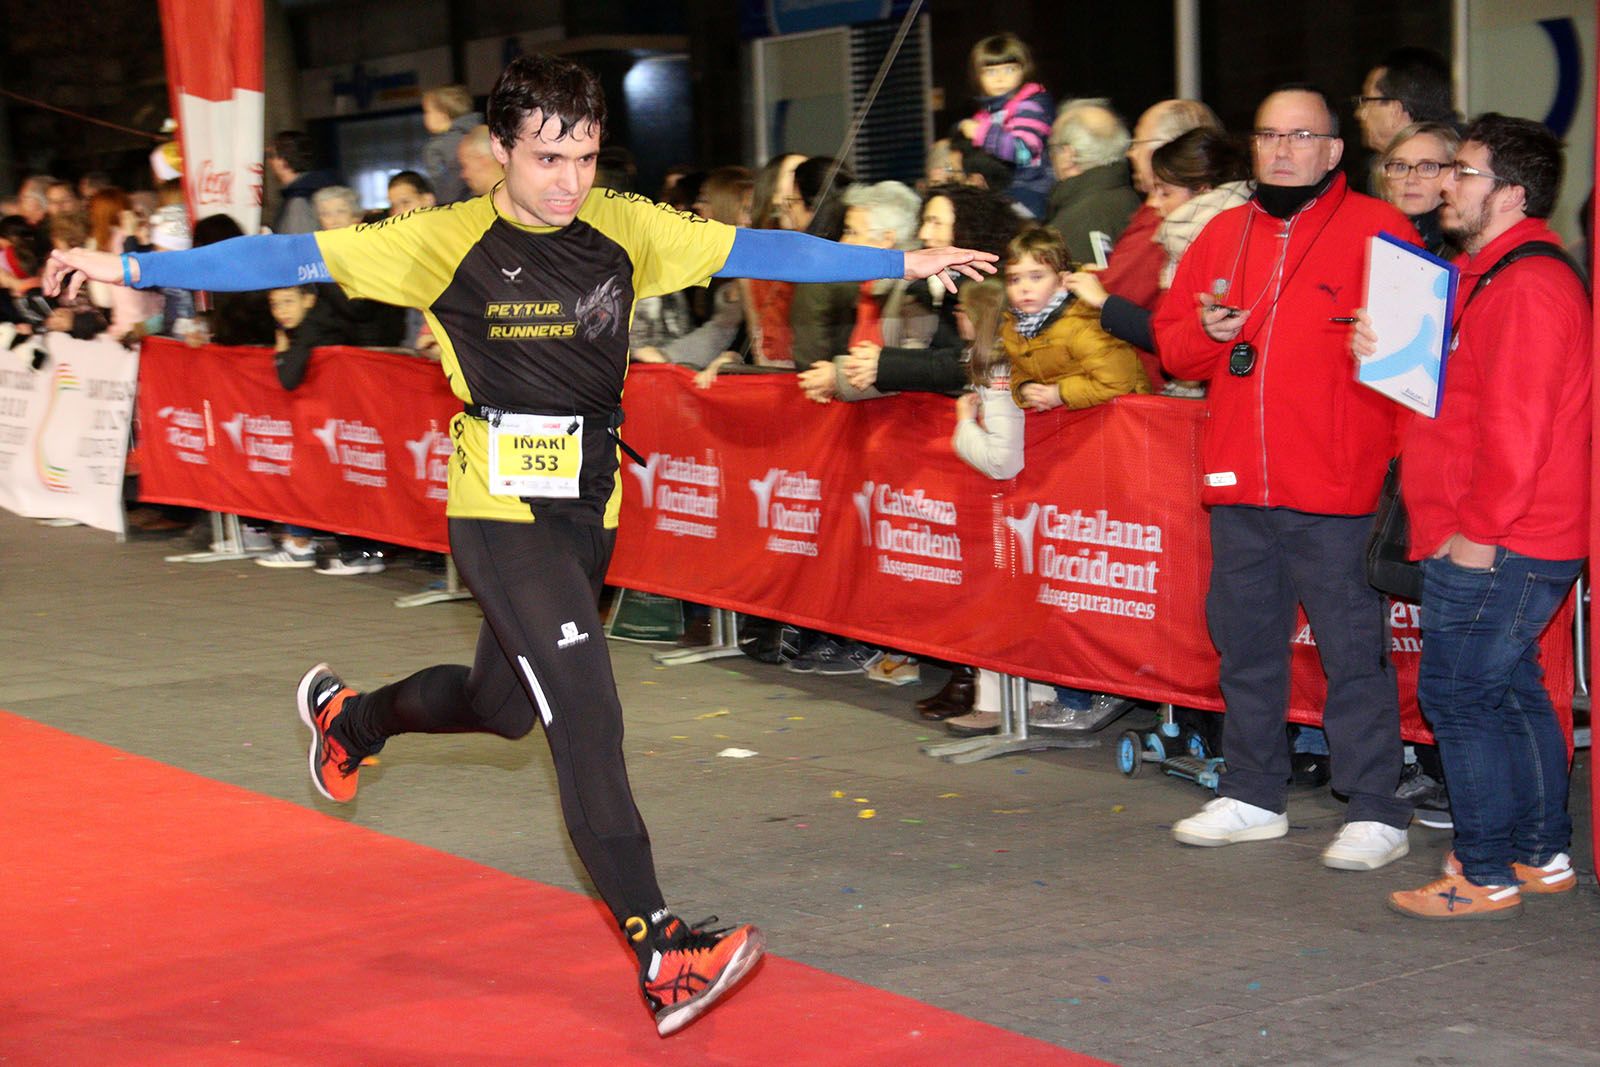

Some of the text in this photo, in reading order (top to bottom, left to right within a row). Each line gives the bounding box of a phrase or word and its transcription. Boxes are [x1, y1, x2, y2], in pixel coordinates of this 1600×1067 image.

[486, 302, 562, 317] PEYTUR
[489, 323, 577, 338] RUNNERS
[514, 435, 565, 450] IÑAKI
[521, 454, 558, 472] 353
[875, 483, 957, 526] Catalana
[876, 519, 962, 561] Occident
[1039, 504, 1163, 552] Catalana
[878, 554, 962, 585] Assegurances
[1039, 544, 1160, 594] Occident
[1036, 583, 1156, 620] Assegurances
